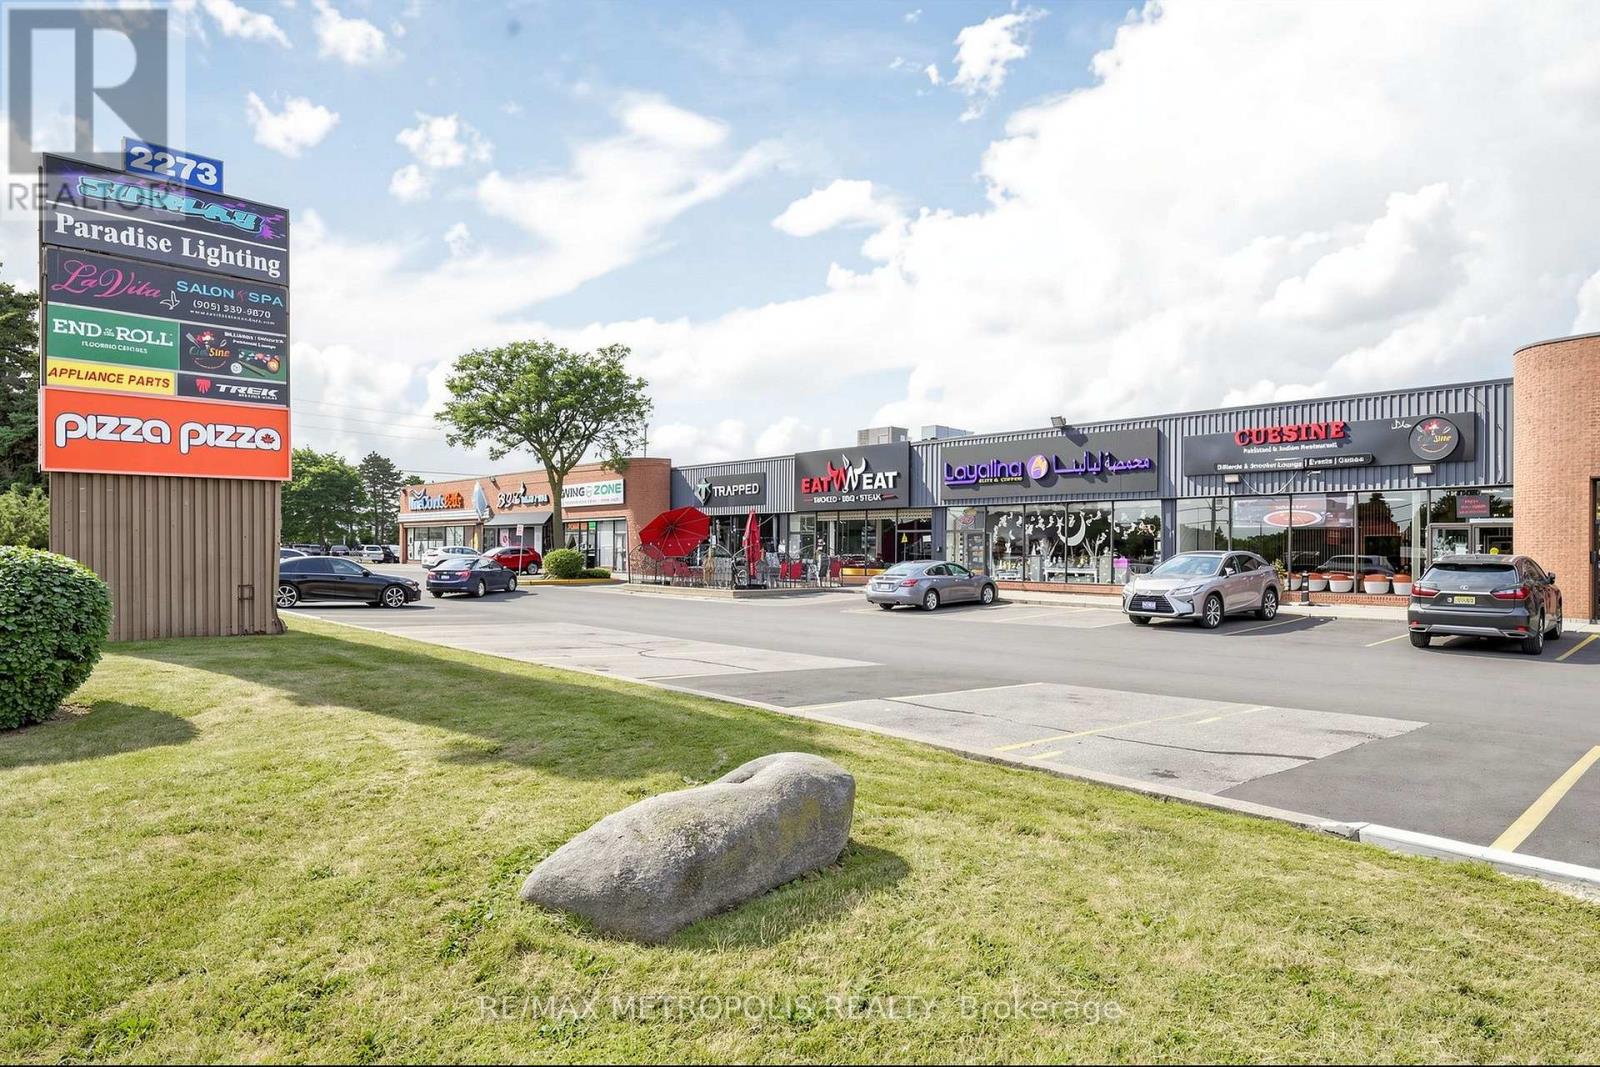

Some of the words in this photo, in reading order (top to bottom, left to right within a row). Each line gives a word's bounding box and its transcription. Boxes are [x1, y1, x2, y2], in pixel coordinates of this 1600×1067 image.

[129, 146, 217, 186] 2273
[55, 212, 172, 252] Paradise
[182, 236, 280, 278] Lighting
[51, 259, 98, 293] La
[94, 268, 160, 298] Vita
[176, 280, 235, 299] SALON
[248, 292, 283, 307] SPA
[52, 318, 102, 337] END
[115, 326, 174, 347] ROLL
[48, 367, 125, 384] APPLIANCE
[128, 374, 170, 389] PARTS
[216, 383, 279, 397] TREK
[1234, 420, 1345, 447] CUESINE
[944, 459, 1023, 486] Layalina
[593, 483, 622, 495] ZONE
[712, 482, 760, 497] TRAPPED
[859, 493, 882, 502] STEAK
